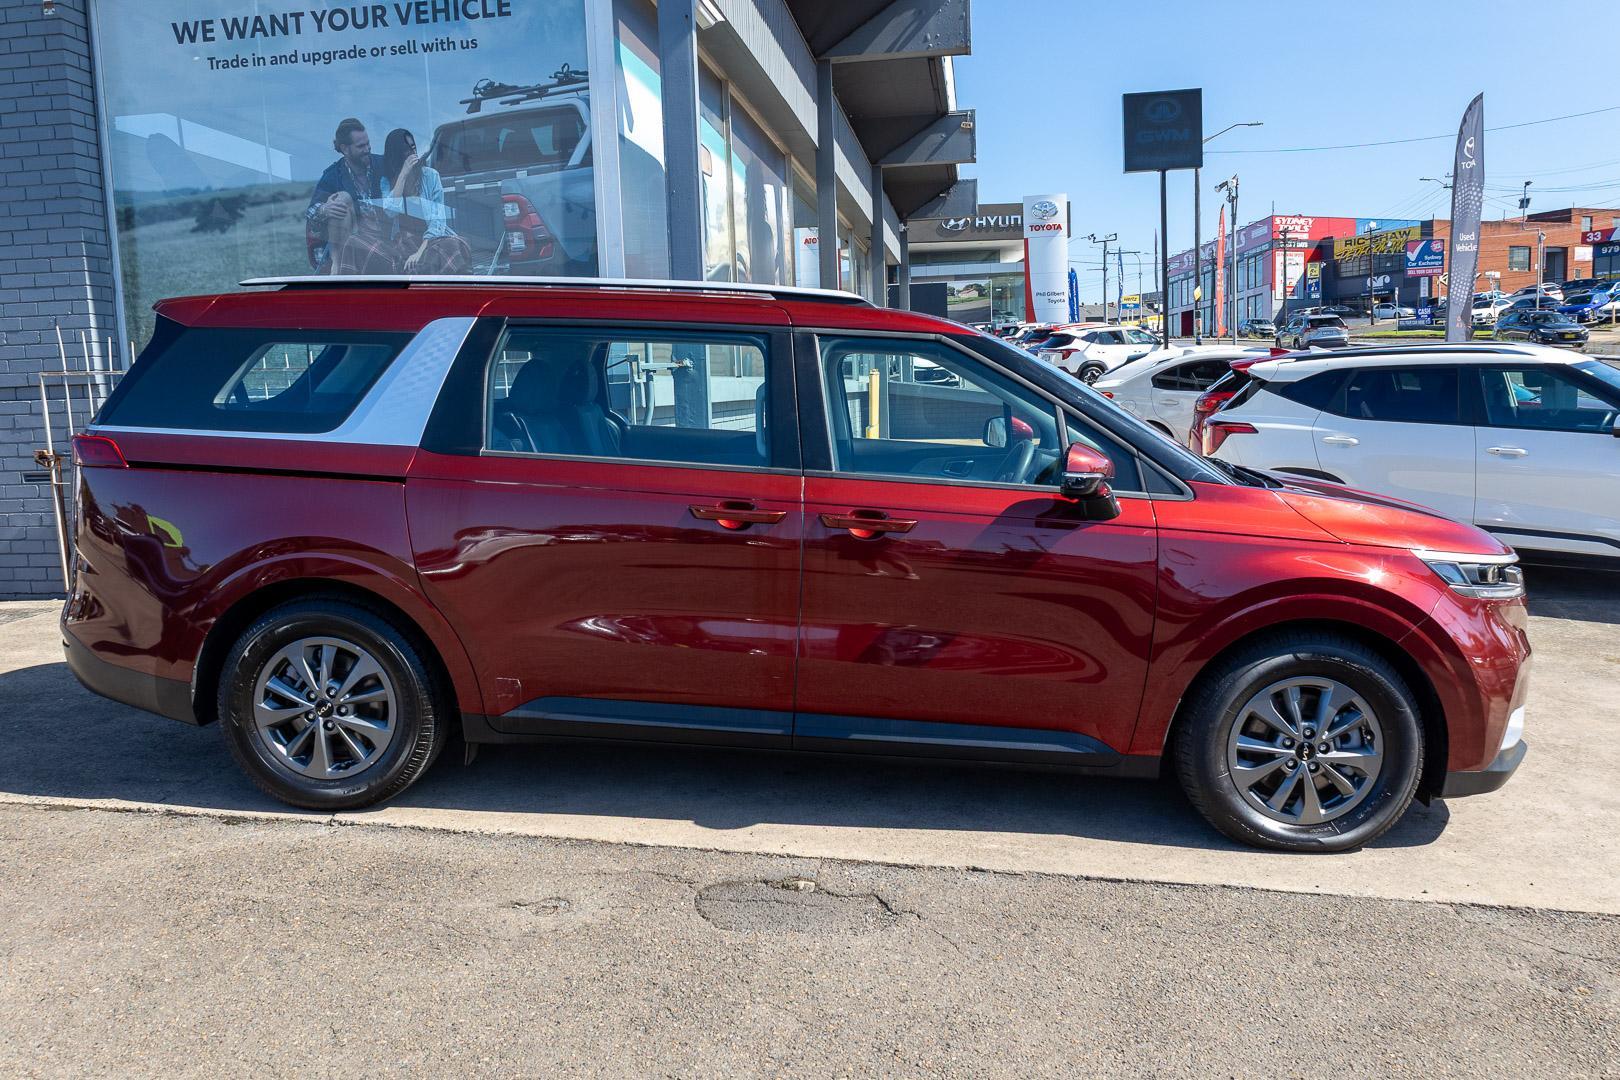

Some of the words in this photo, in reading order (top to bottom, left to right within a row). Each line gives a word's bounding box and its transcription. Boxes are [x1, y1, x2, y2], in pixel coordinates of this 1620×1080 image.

[171, 20, 216, 45] WE
[220, 12, 305, 41] WANT
[310, 4, 389, 33] YOUR
[394, 0, 512, 26] VEHICLE
[207, 54, 249, 71] Trade
[252, 53, 266, 67] in
[269, 49, 299, 66] and
[302, 44, 367, 66] upgrade
[370, 44, 387, 57] or
[390, 39, 419, 56] sell
[421, 36, 456, 53] with
[460, 36, 478, 50] us
[1274, 217, 1315, 225] SYDNEY
[1028, 223, 1063, 232] TOYOTA
[1459, 232, 1475, 241] Used
[1586, 231, 1602, 242] 33
[1417, 307, 1431, 315] CASH
